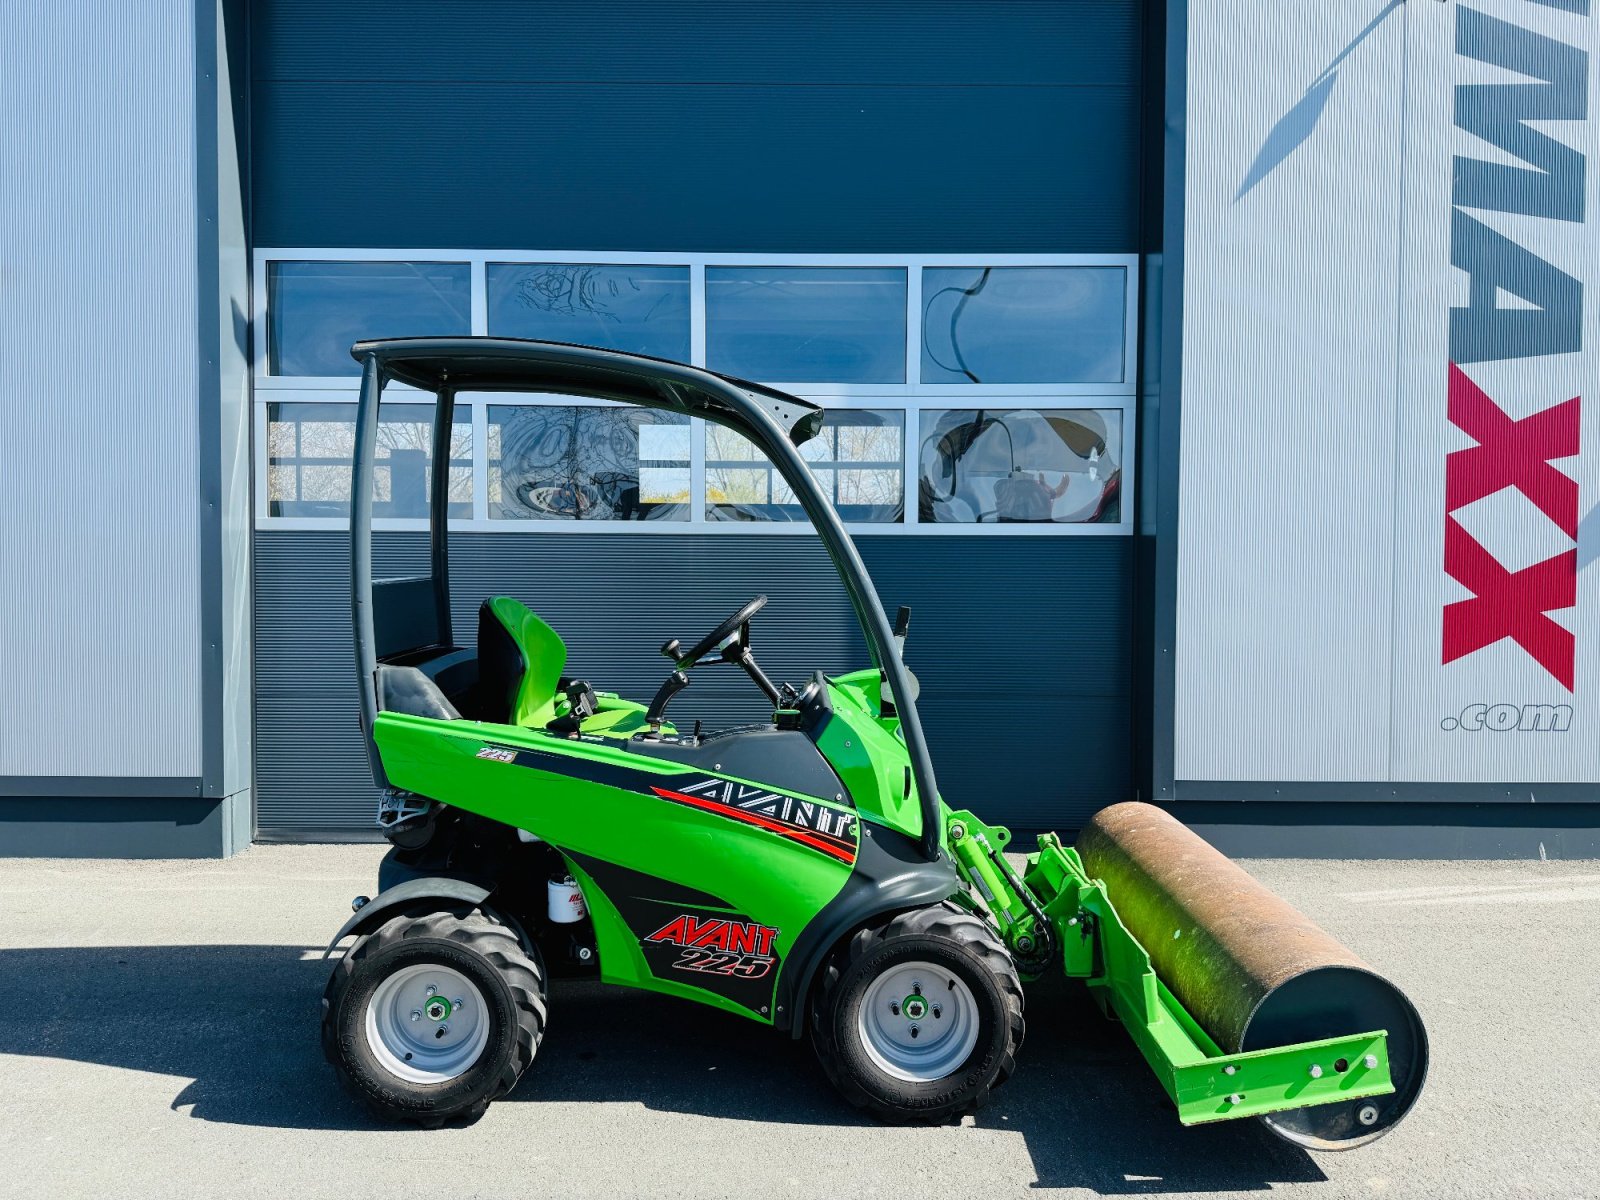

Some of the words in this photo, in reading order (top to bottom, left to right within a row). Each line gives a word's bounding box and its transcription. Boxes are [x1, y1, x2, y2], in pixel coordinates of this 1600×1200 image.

[1442, 0, 1591, 694] MAXX
[1441, 704, 1573, 731] .com
[475, 747, 516, 763] 225
[677, 778, 856, 838] AVANT
[644, 914, 780, 957] AVANT
[671, 948, 776, 979] 225
